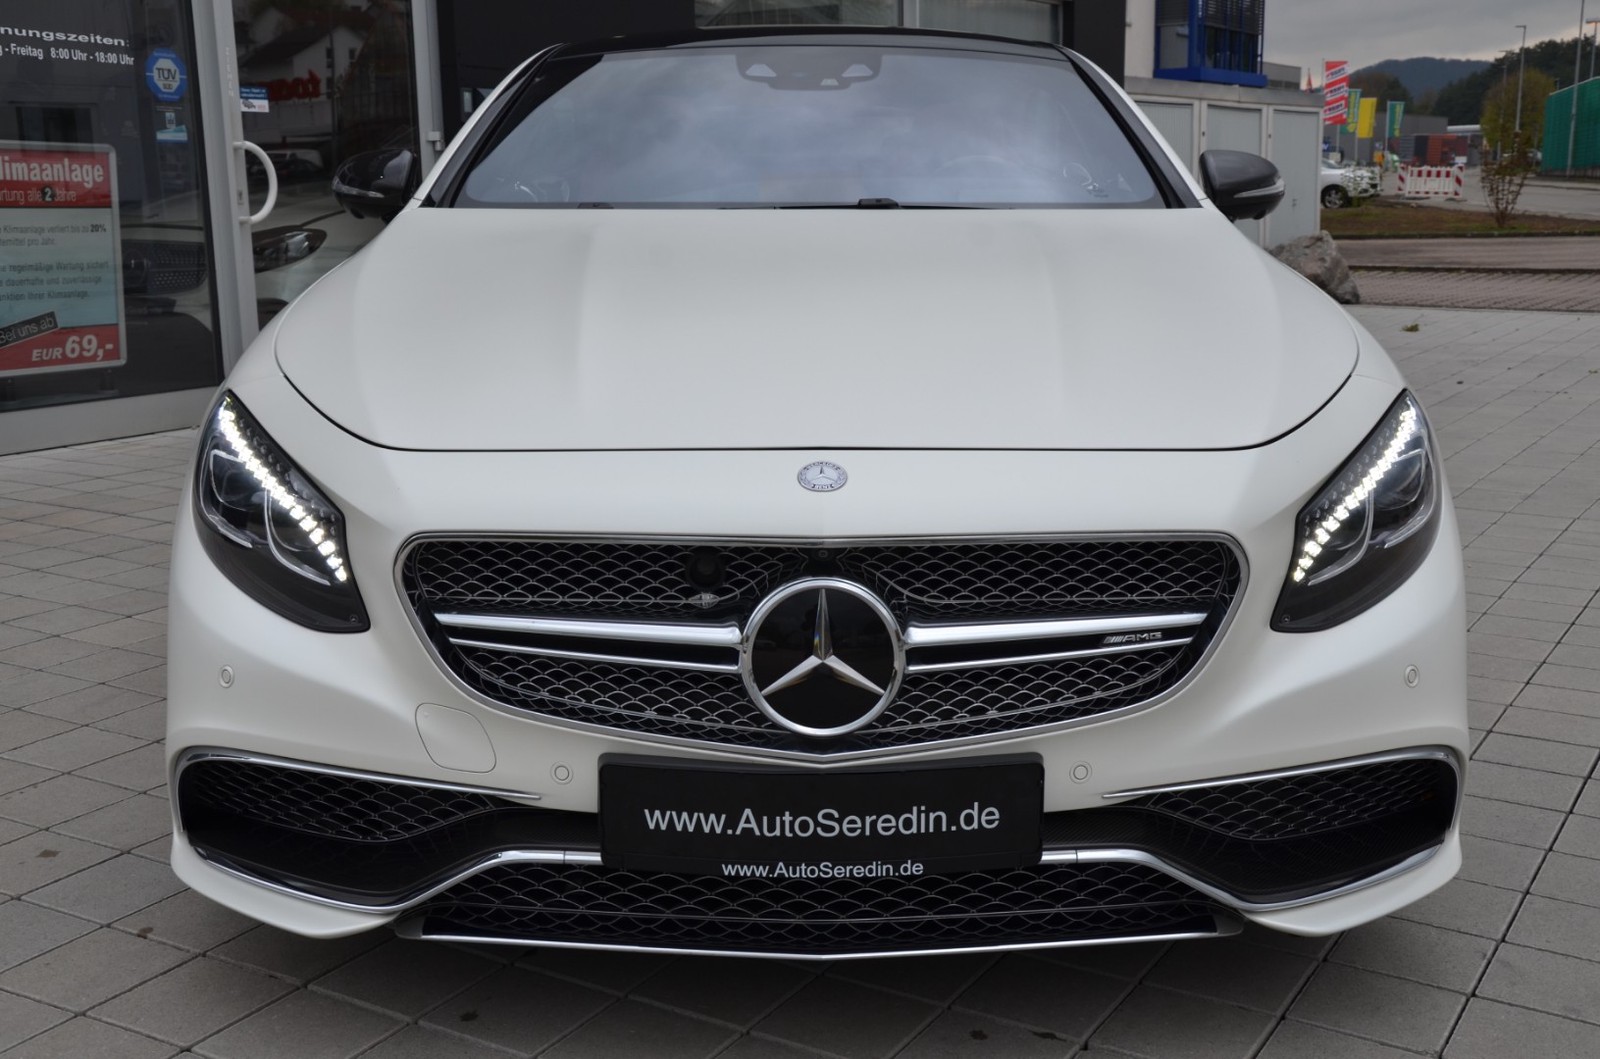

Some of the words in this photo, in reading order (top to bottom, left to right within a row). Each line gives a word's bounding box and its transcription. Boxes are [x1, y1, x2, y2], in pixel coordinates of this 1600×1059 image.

[10, 43, 44, 60] Freitag
[50, 47, 70, 60] 8:00
[71, 49, 88, 61] Uhr
[95, 51, 118, 64] 18:00
[119, 53, 135, 66] Uhr
[27, 188, 42, 201] alle
[44, 187, 52, 202] 2
[90, 223, 107, 233] 20%
[17, 324, 39, 338] uns
[39, 315, 55, 330] ab
[31, 346, 64, 362] EUR
[65, 333, 115, 361] 69,-
[1121, 631, 1163, 643] AMG
[643, 802, 1001, 838] www.AutoSeredin.de
[721, 859, 925, 879] www.AutoSeredin.de
